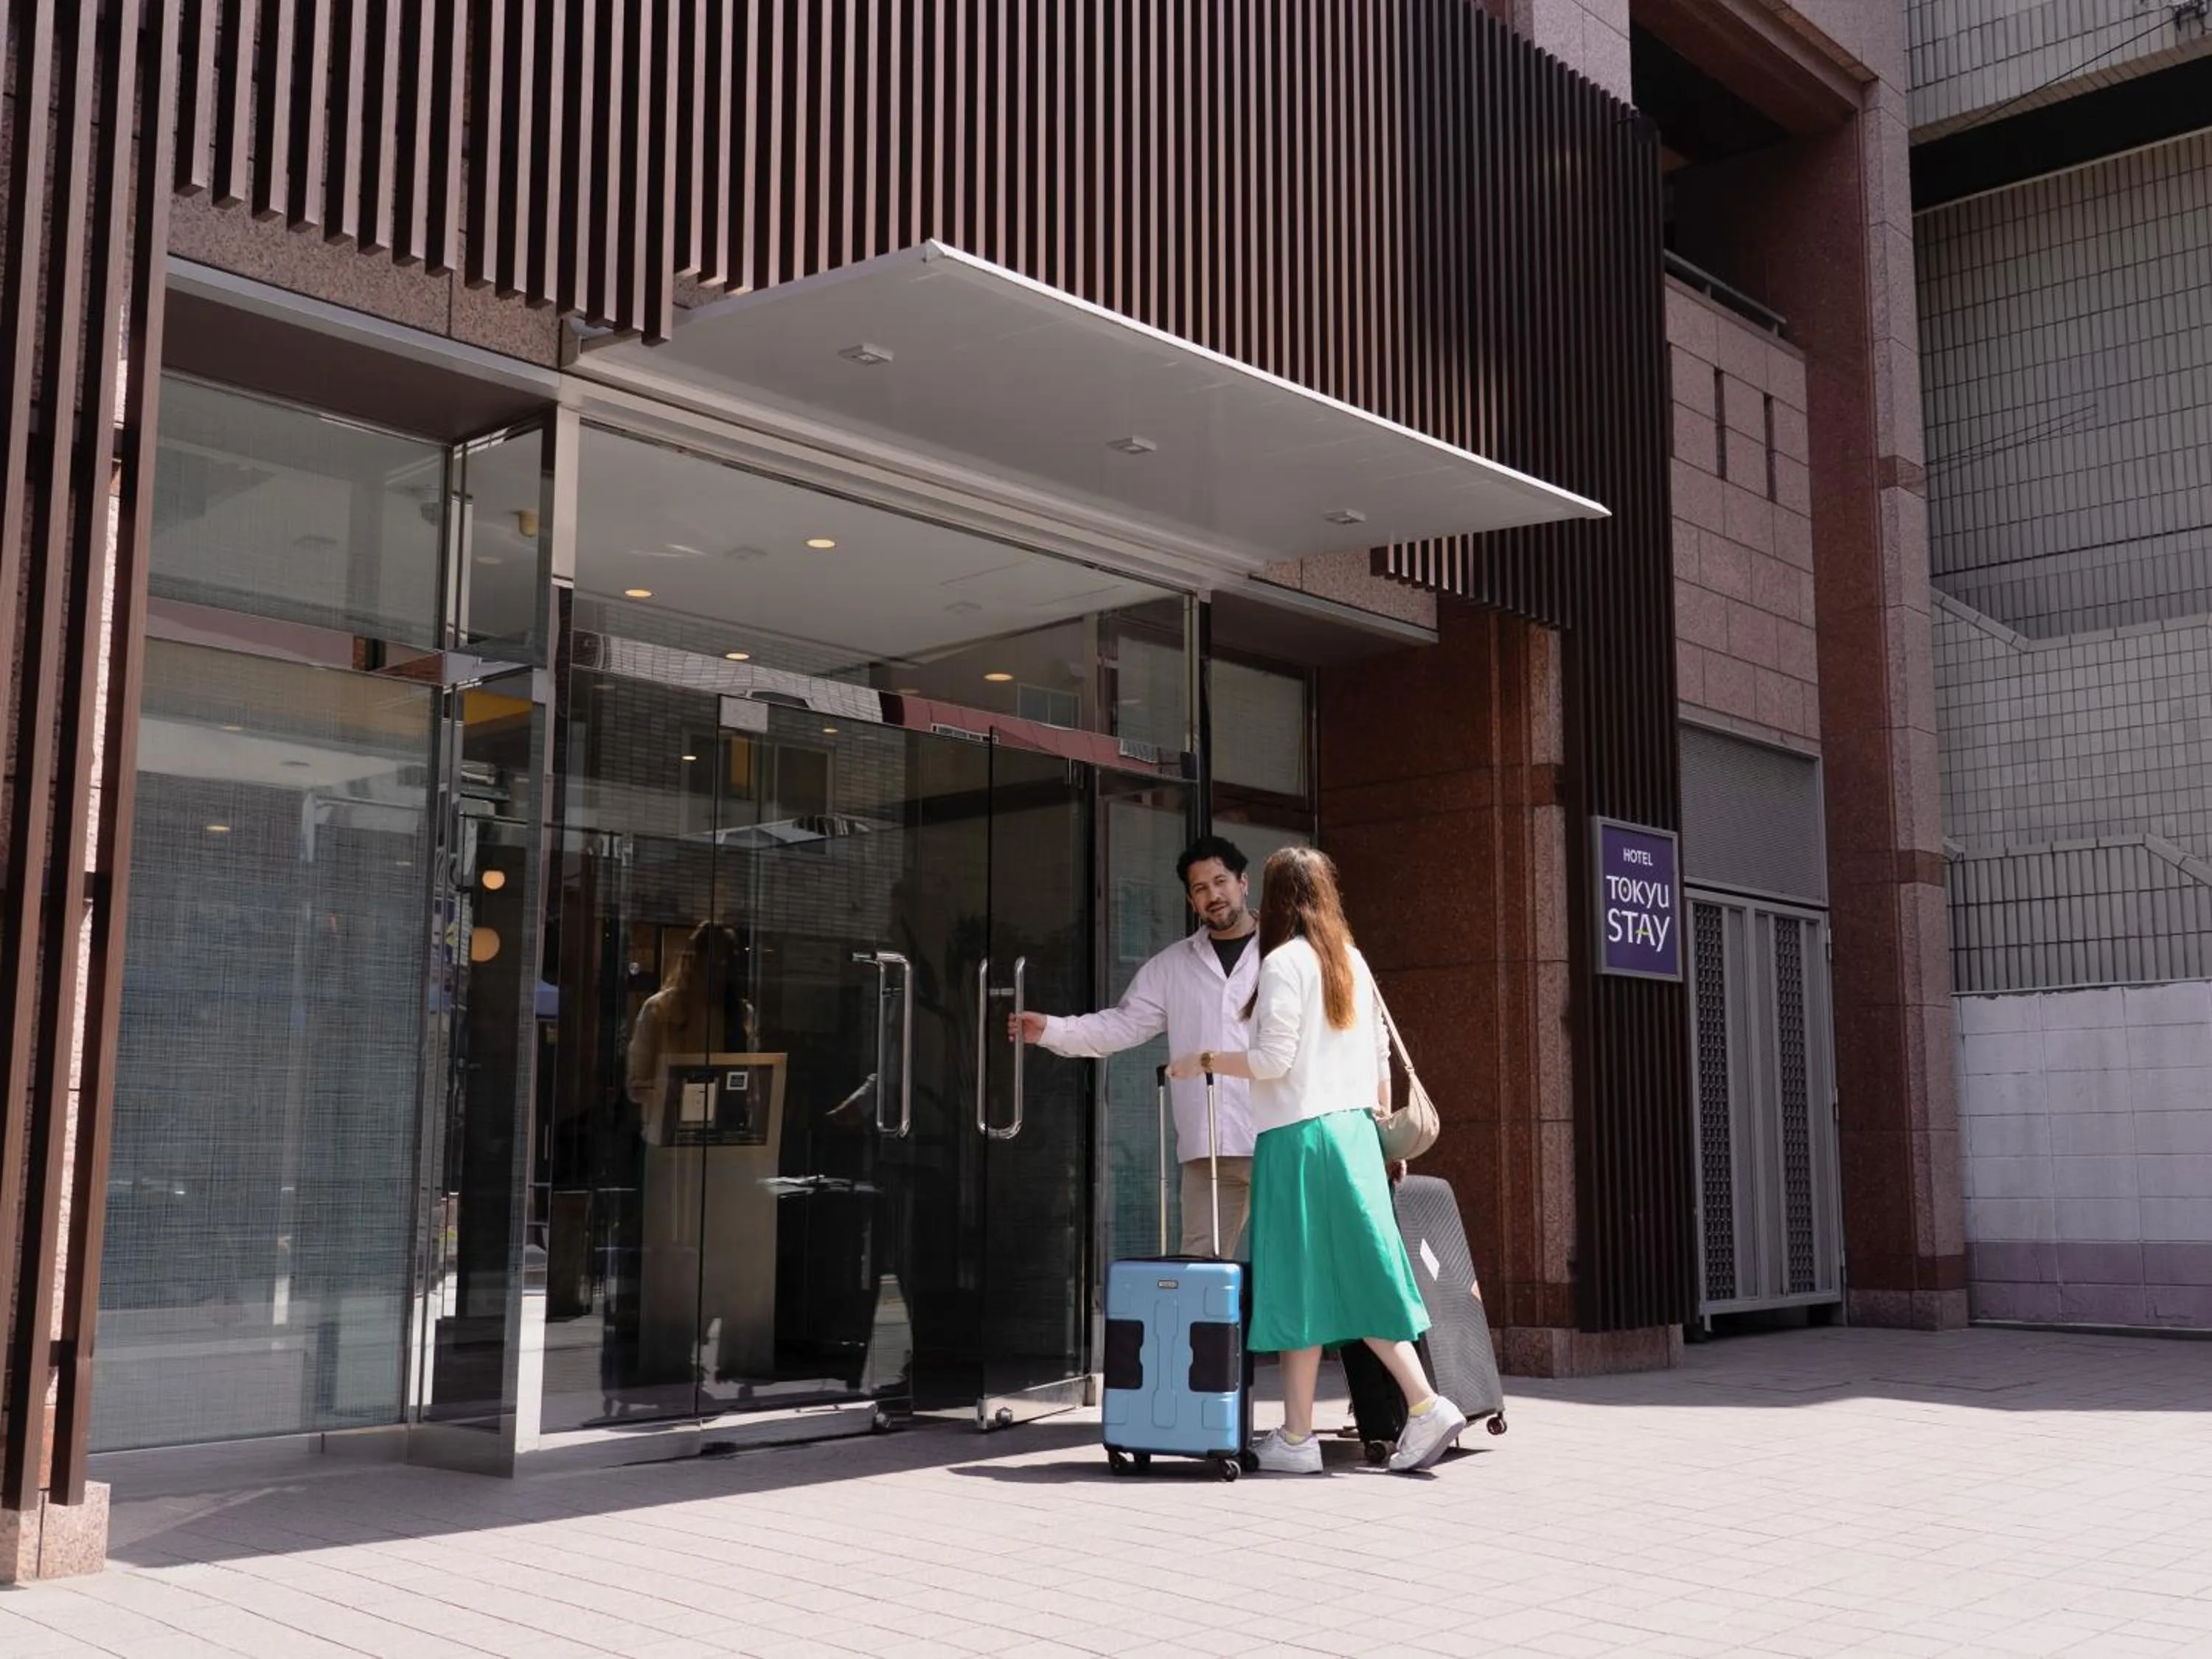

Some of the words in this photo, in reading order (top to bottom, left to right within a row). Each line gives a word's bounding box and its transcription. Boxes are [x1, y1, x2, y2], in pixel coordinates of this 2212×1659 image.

[1623, 849, 1653, 866] HOTEL
[1605, 874, 1669, 909] TOKYU
[1607, 908, 1671, 952] STAY
